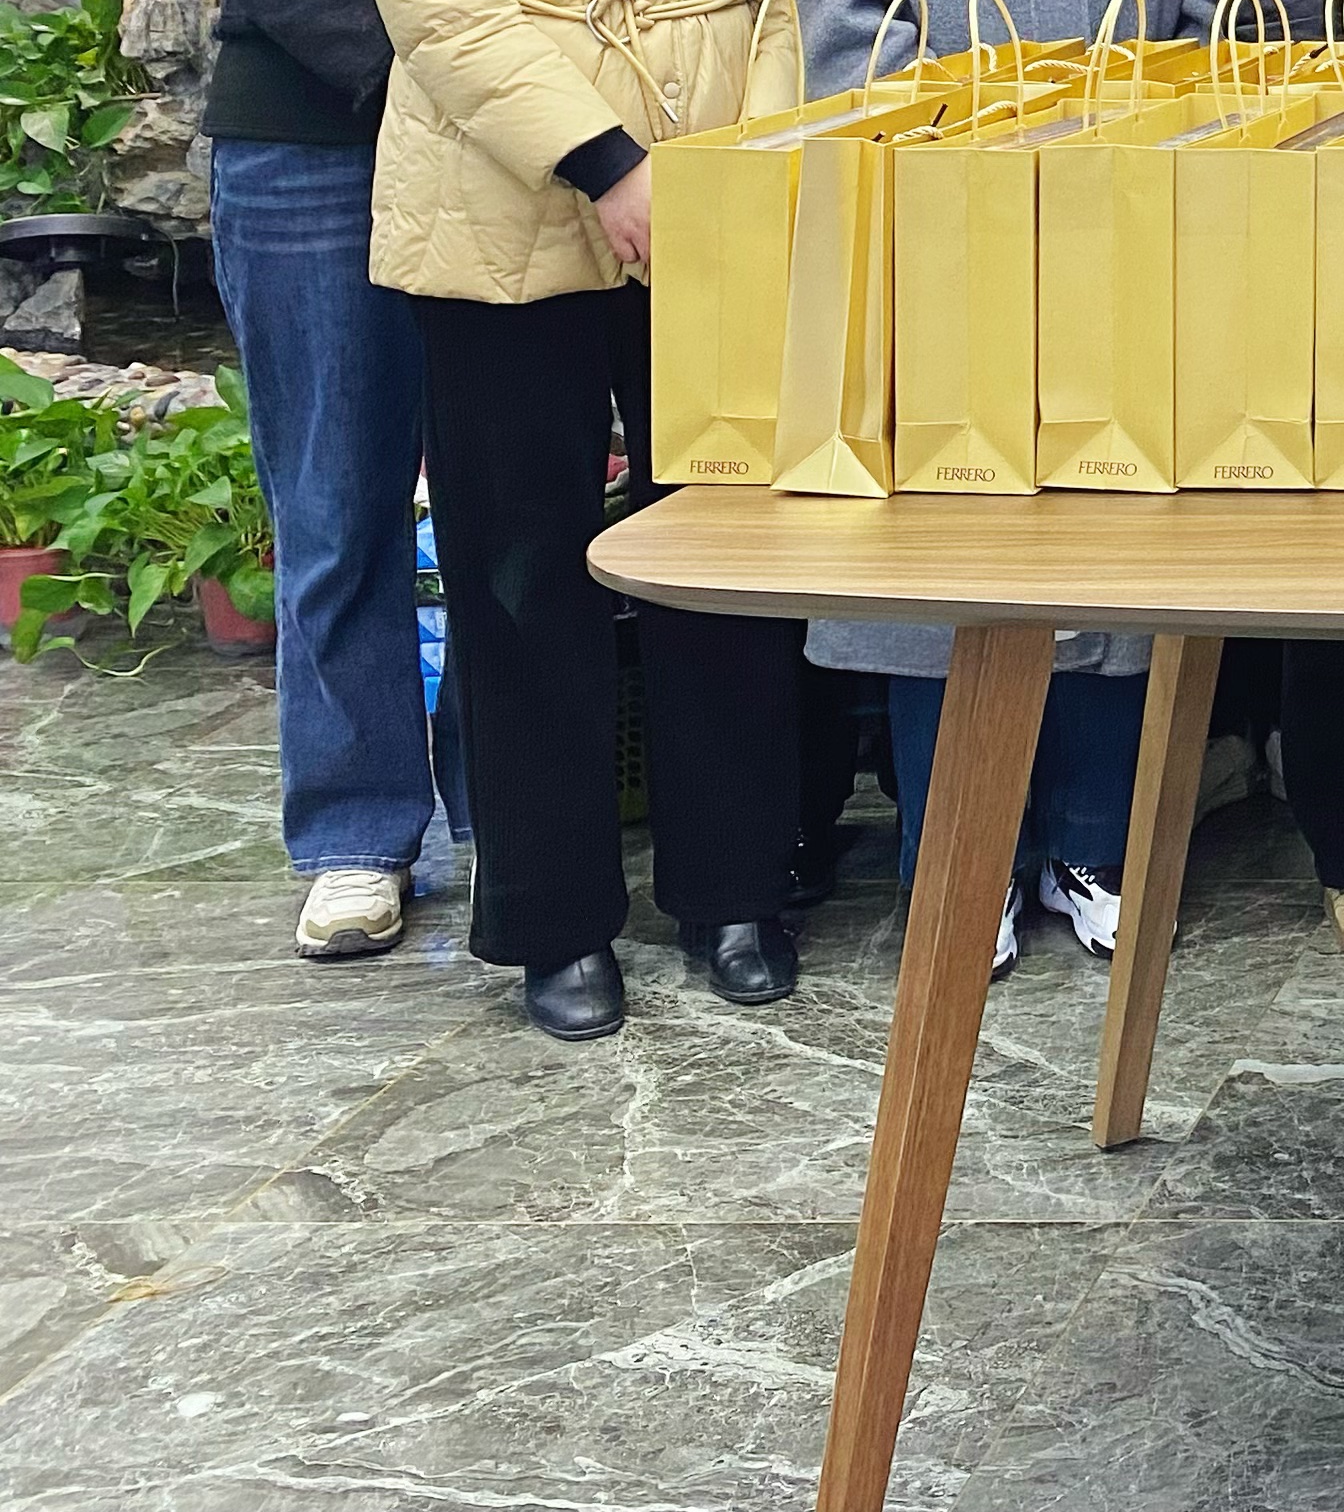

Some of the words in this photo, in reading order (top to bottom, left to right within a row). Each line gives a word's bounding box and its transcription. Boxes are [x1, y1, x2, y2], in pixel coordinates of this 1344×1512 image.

[689, 459, 749, 476] FERRERO
[936, 466, 996, 482] FERRERO
[1078, 460, 1137, 477] FERRERO
[1213, 465, 1274, 480] FERRERO
